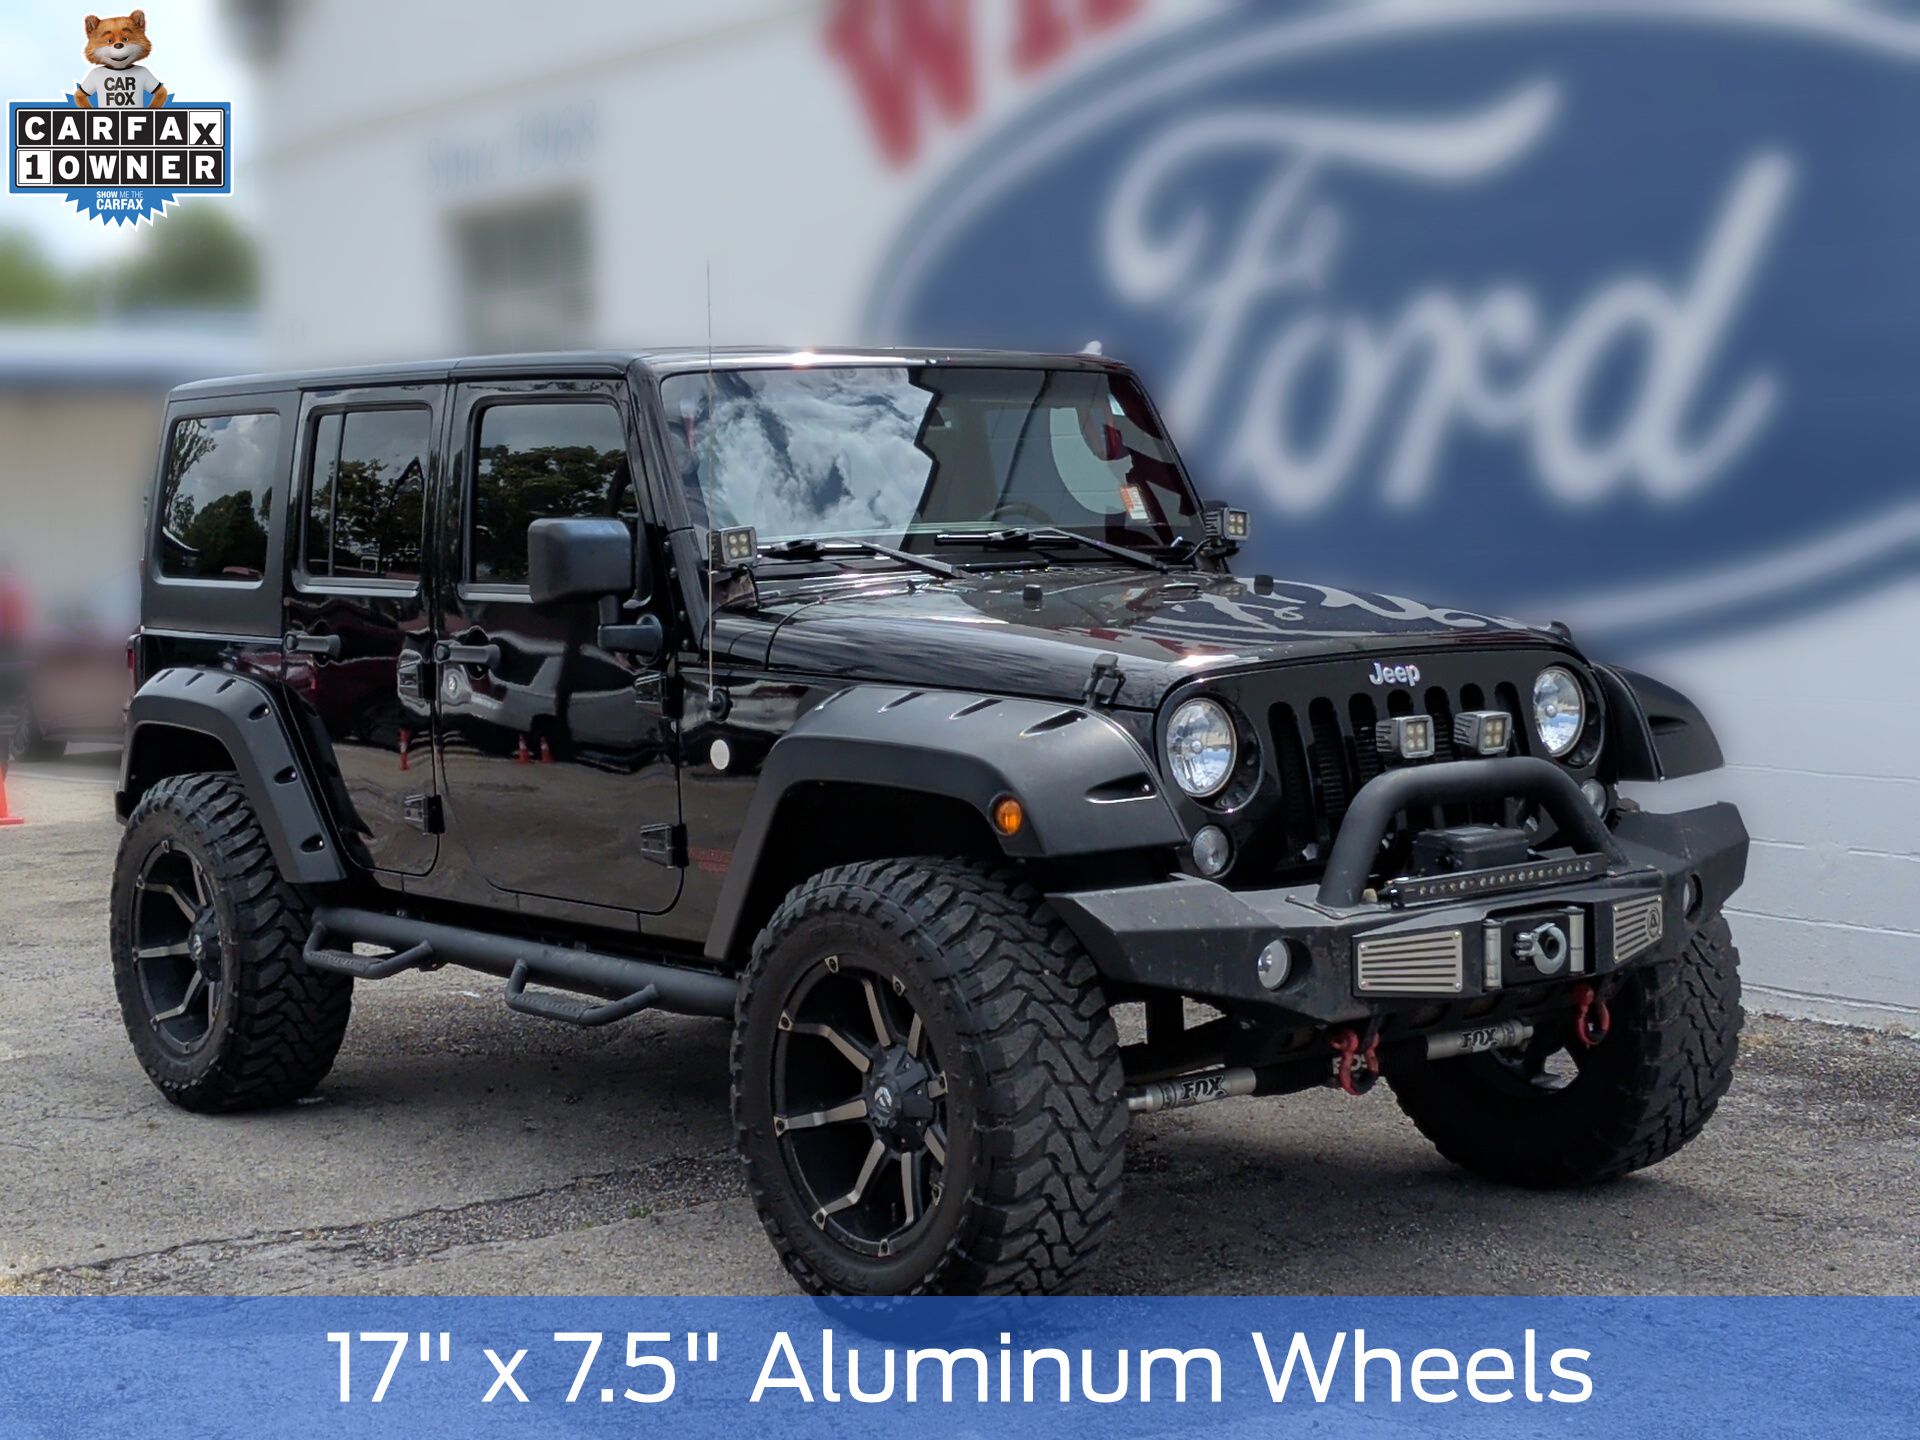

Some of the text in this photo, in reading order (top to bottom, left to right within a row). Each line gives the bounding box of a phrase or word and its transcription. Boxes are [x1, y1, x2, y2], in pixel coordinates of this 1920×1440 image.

[1104, 74, 1796, 512] Ford
[1369, 662, 1421, 687] Jeep
[1460, 1027, 1498, 1050] FOX
[1181, 1075, 1225, 1100] FOX
